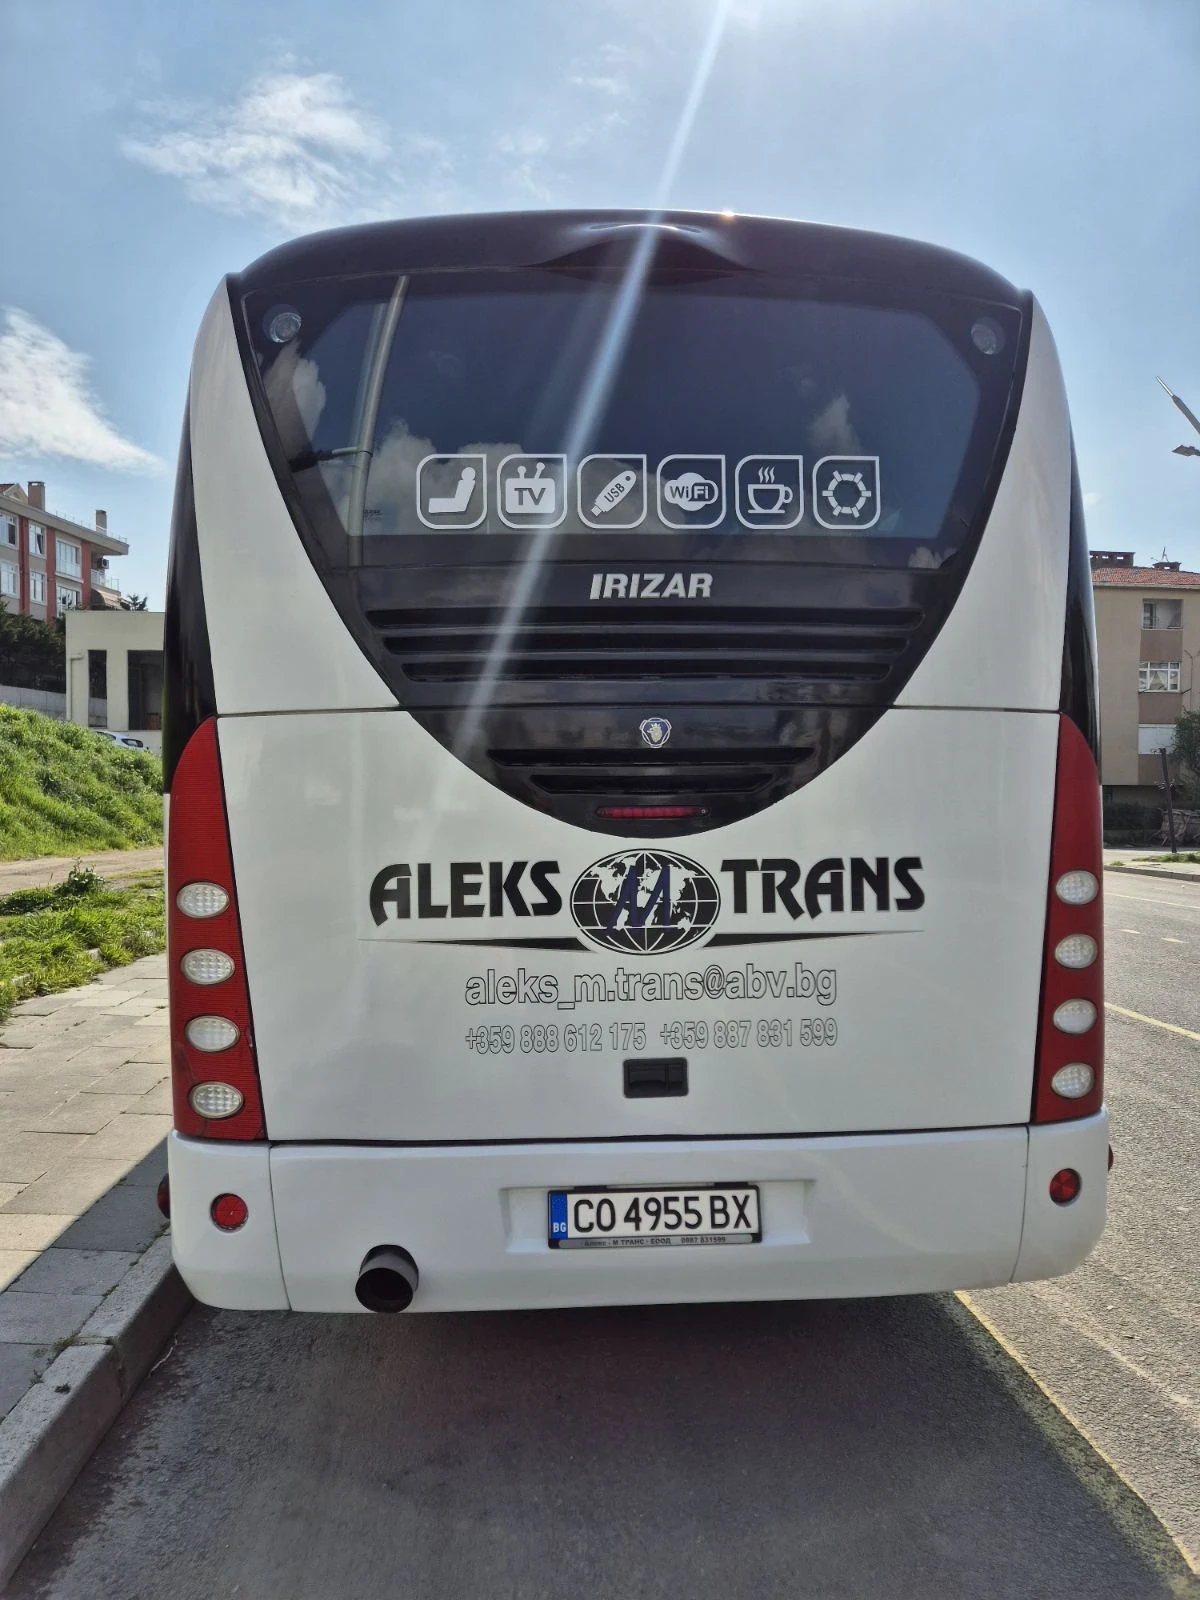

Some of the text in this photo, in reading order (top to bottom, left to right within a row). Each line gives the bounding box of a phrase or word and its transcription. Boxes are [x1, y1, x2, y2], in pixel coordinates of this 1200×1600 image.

[514, 487, 547, 506] TV
[604, 482, 625, 503] USB
[670, 485, 709, 499] WiFi
[589, 572, 714, 600] IRIZAR
[369, 860, 563, 927] ALEKS
[720, 856, 926, 921] TRANS
[464, 962, 838, 1010] aleks_m.trans@abv.bg
[464, 1017, 838, 1055] +359 888 612 175 +359 887 831 599
[623, 1195, 703, 1231] 4955
[553, 1222, 567, 1233] BG
